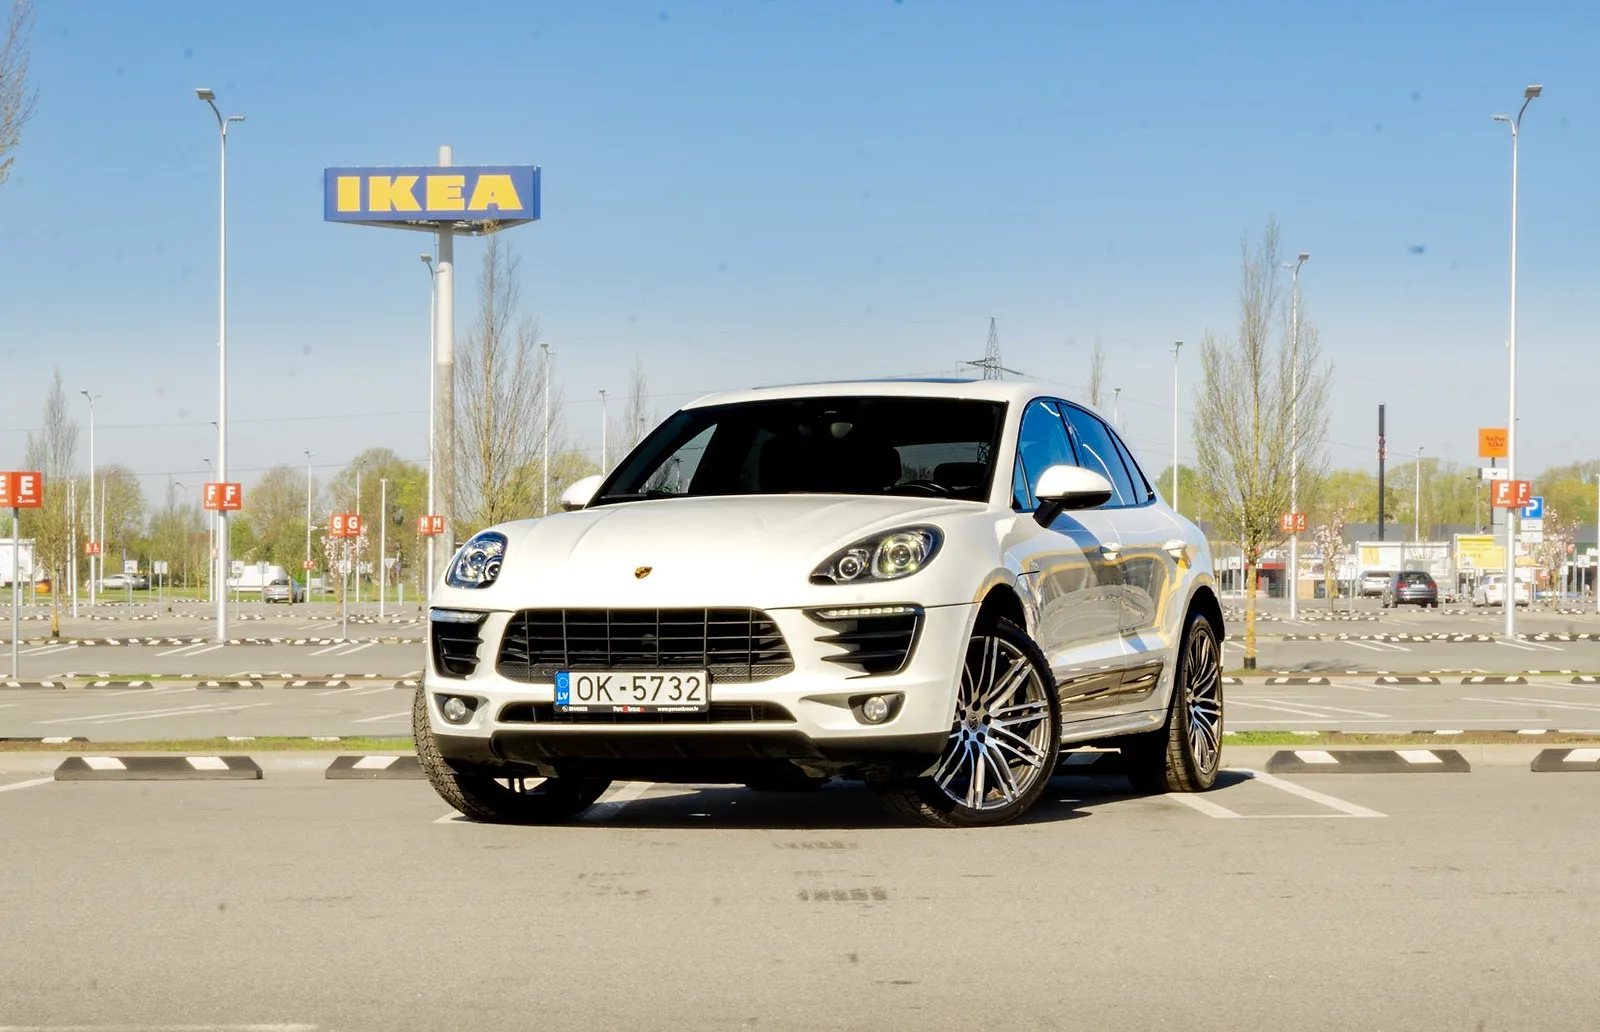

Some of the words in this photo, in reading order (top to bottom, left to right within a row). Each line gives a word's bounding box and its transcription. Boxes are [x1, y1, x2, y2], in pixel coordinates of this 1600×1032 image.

[337, 175, 523, 212] IKEA
[20, 475, 34, 495] E
[208, 485, 216, 501] F
[225, 485, 236, 501] F
[1499, 482, 1510, 498] F
[1519, 483, 1527, 498] F
[1525, 498, 1539, 517] P
[333, 516, 342, 529] G
[347, 516, 358, 529] G
[421, 517, 428, 528] H
[432, 517, 441, 528] H
[557, 691, 569, 700] LV
[577, 675, 701, 702] OK-5732
